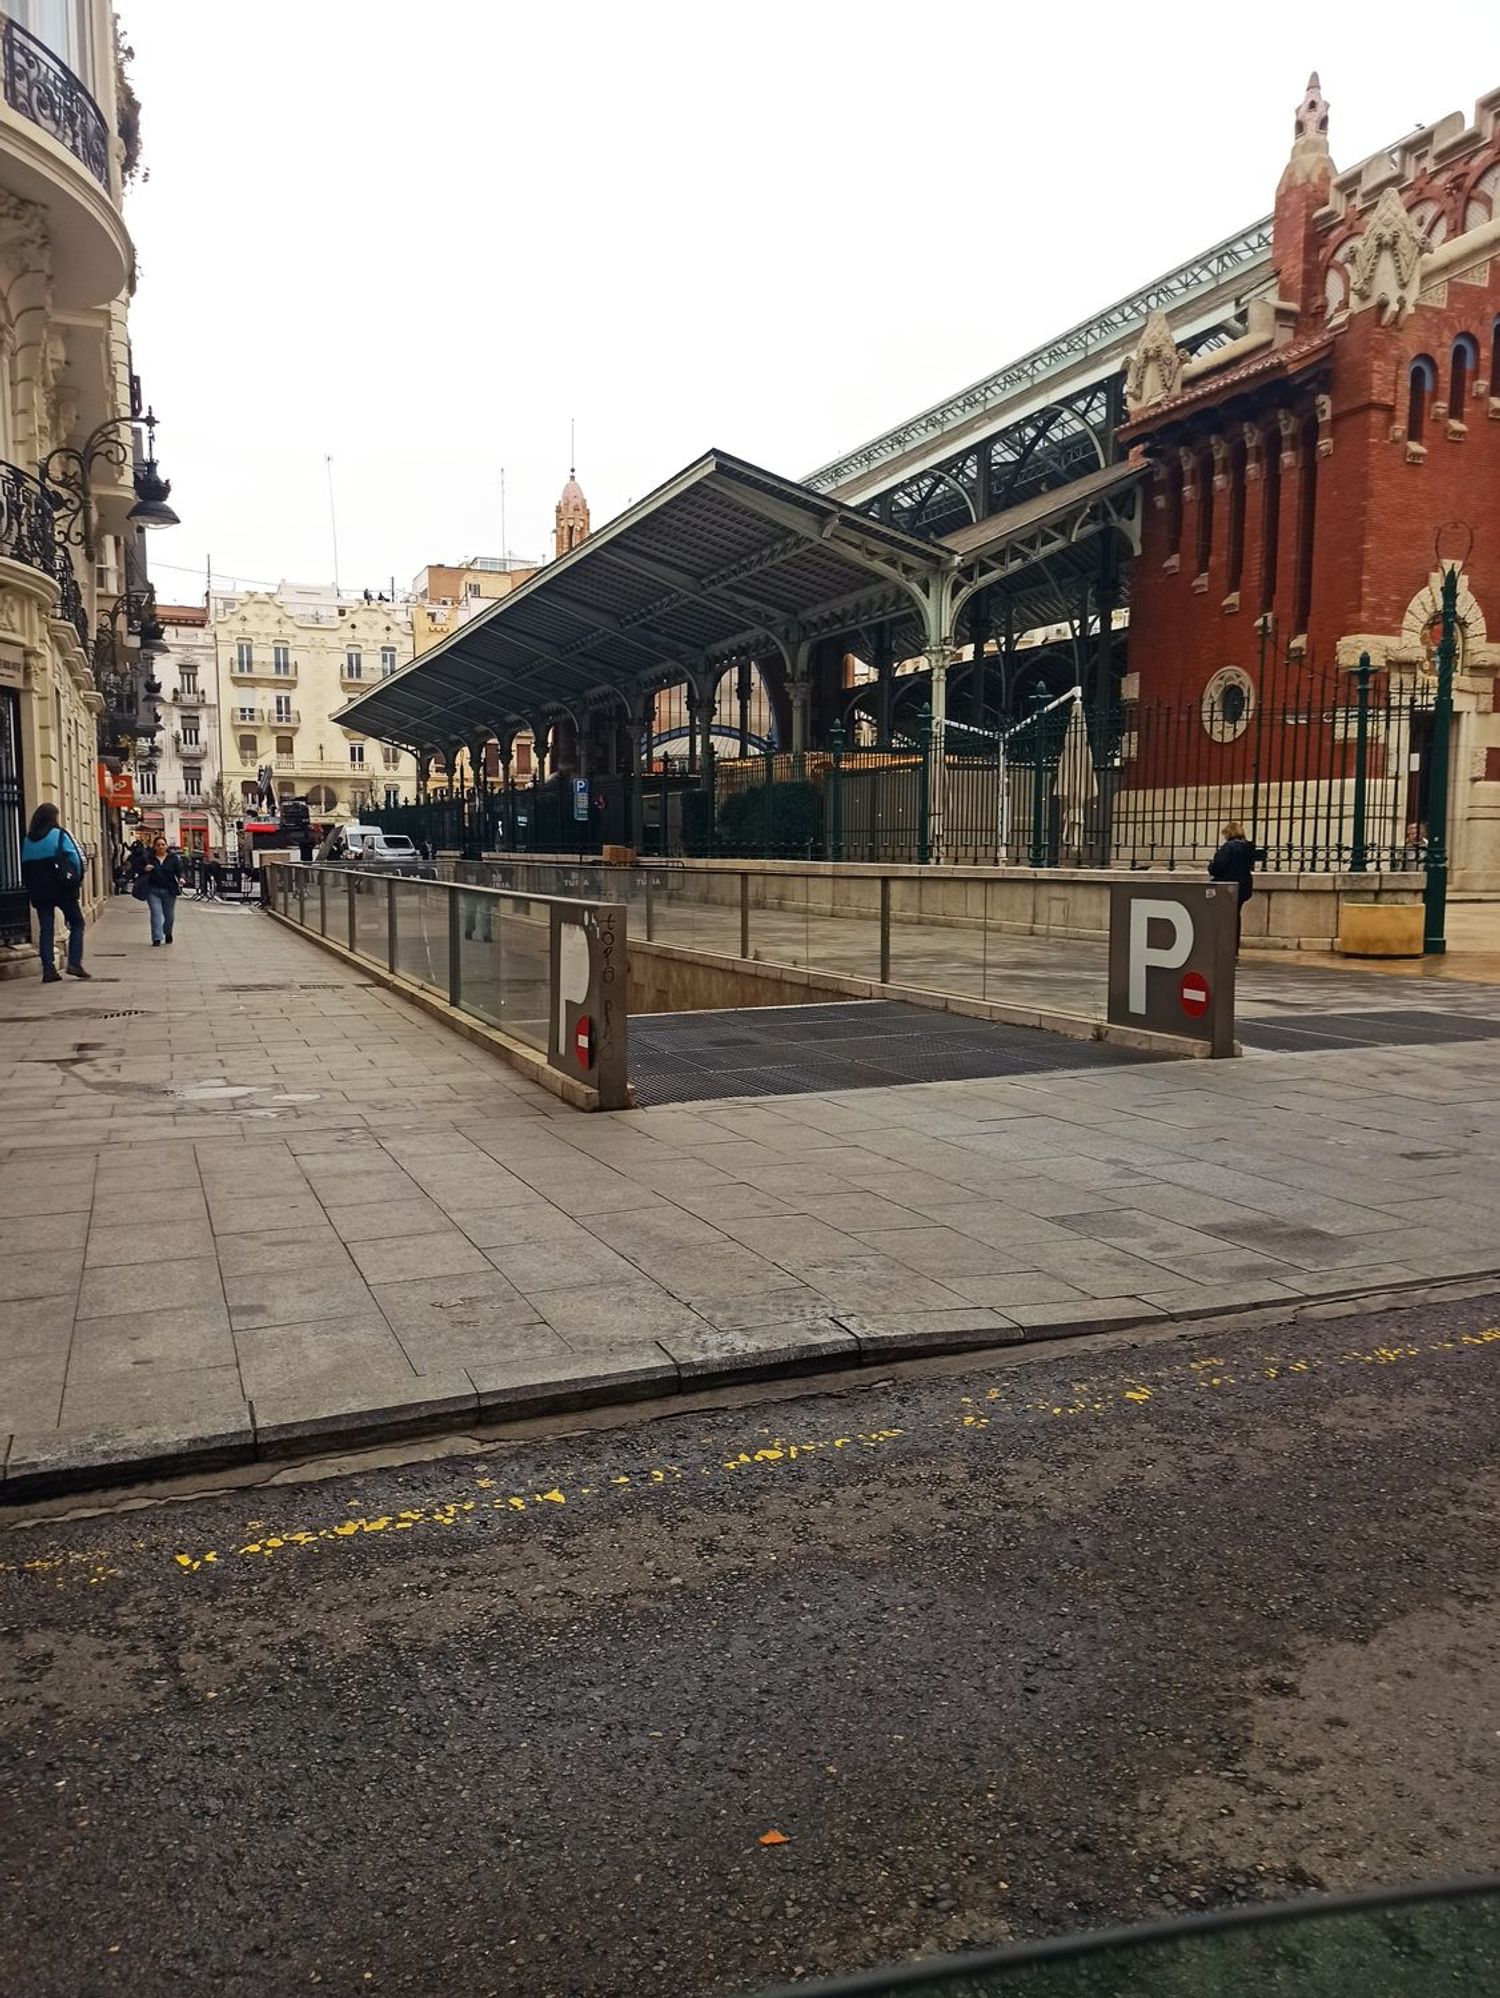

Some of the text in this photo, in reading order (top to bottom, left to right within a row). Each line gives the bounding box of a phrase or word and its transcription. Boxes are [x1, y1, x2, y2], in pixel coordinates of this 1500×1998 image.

[576, 780, 586, 792] P
[558, 921, 590, 1056] P
[1129, 898, 1194, 1015] P
